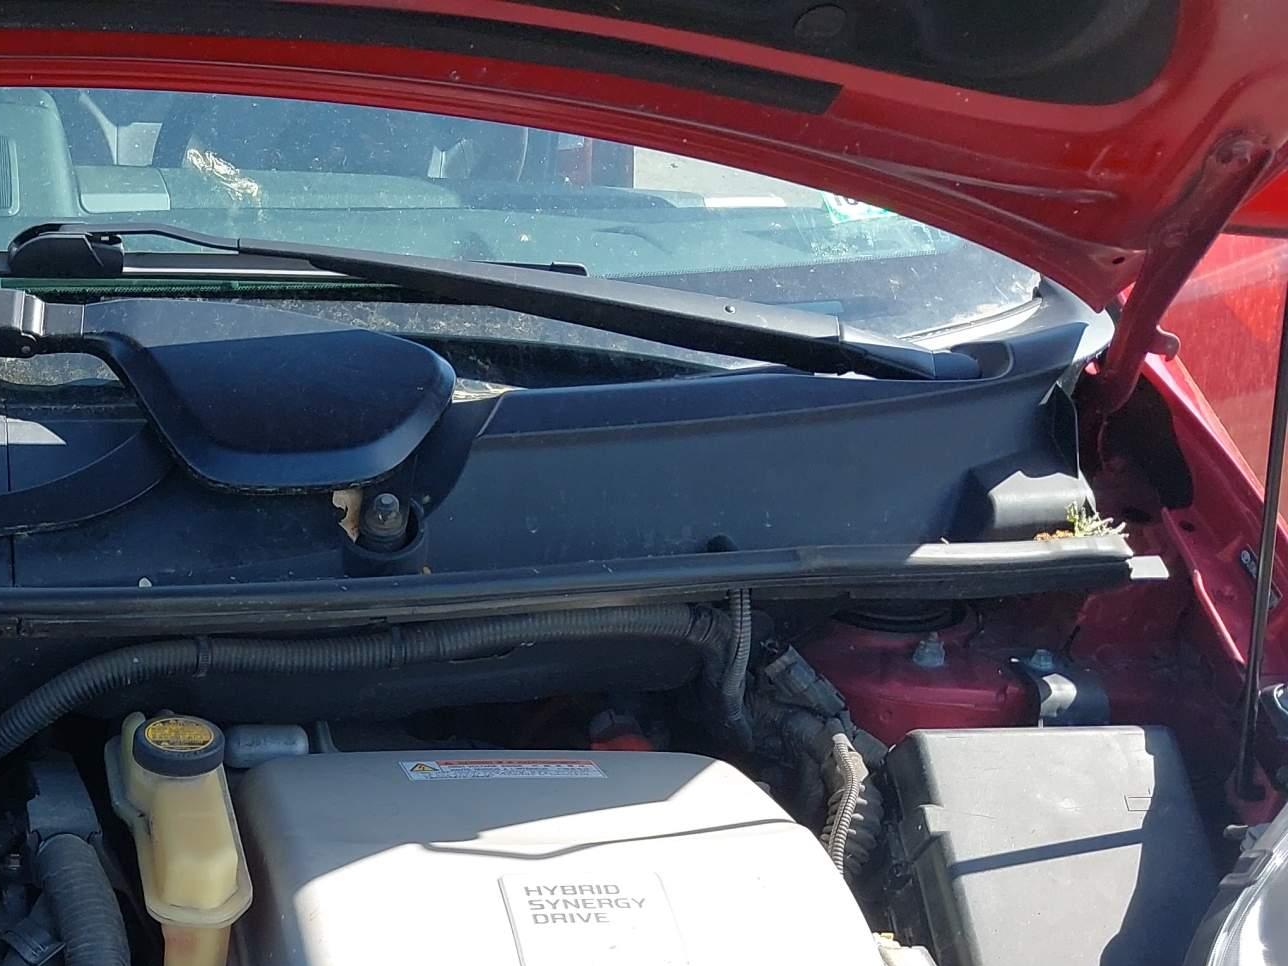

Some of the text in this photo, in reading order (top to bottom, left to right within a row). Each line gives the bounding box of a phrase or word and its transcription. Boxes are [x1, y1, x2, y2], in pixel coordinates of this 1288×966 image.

[524, 884, 620, 896] HYBRID
[528, 898, 645, 910] SYNERGY
[532, 912, 610, 924] DRIVE
